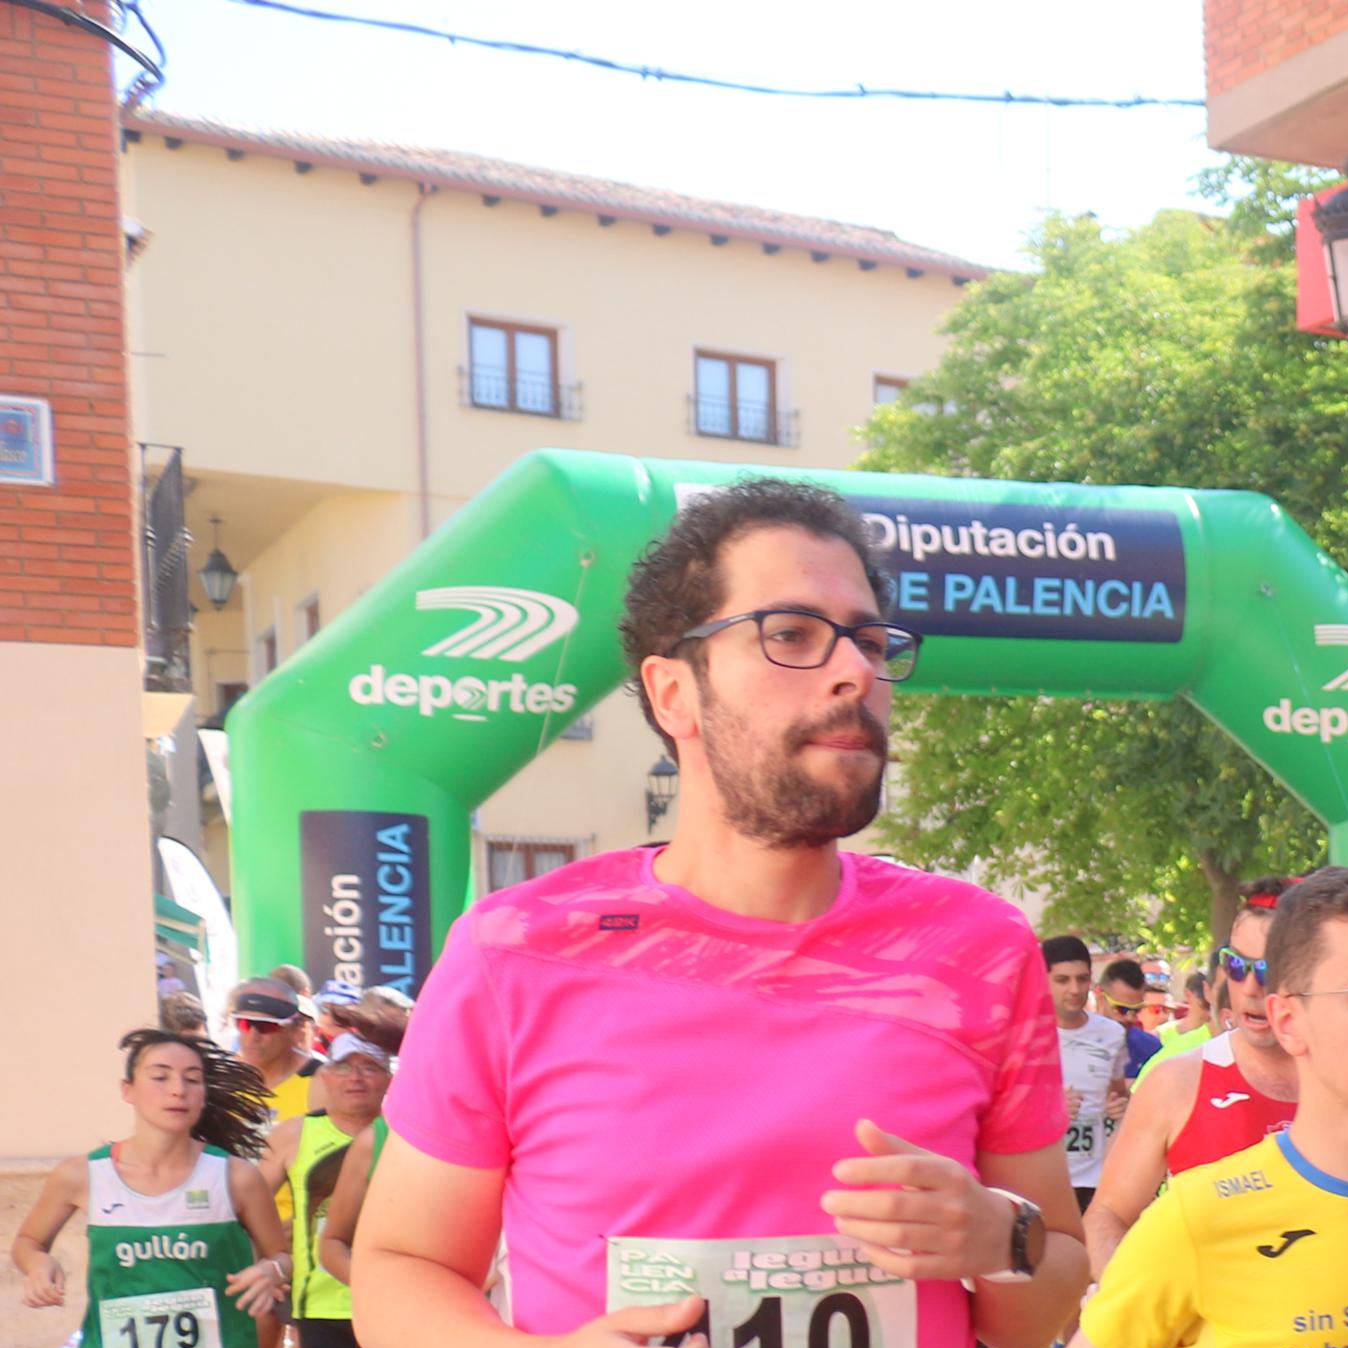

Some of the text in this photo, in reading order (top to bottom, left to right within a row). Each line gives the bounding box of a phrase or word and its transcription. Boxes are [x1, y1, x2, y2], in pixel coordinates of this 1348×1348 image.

[862, 512, 1117, 561] Diputación
[886, 569, 1175, 619] E PALENCIA
[349, 664, 578, 718] deportes
[1214, 1171, 1273, 1199] ISMAEL
[116, 1232, 207, 1267] gullón
[1294, 1309, 1334, 1333] sin
